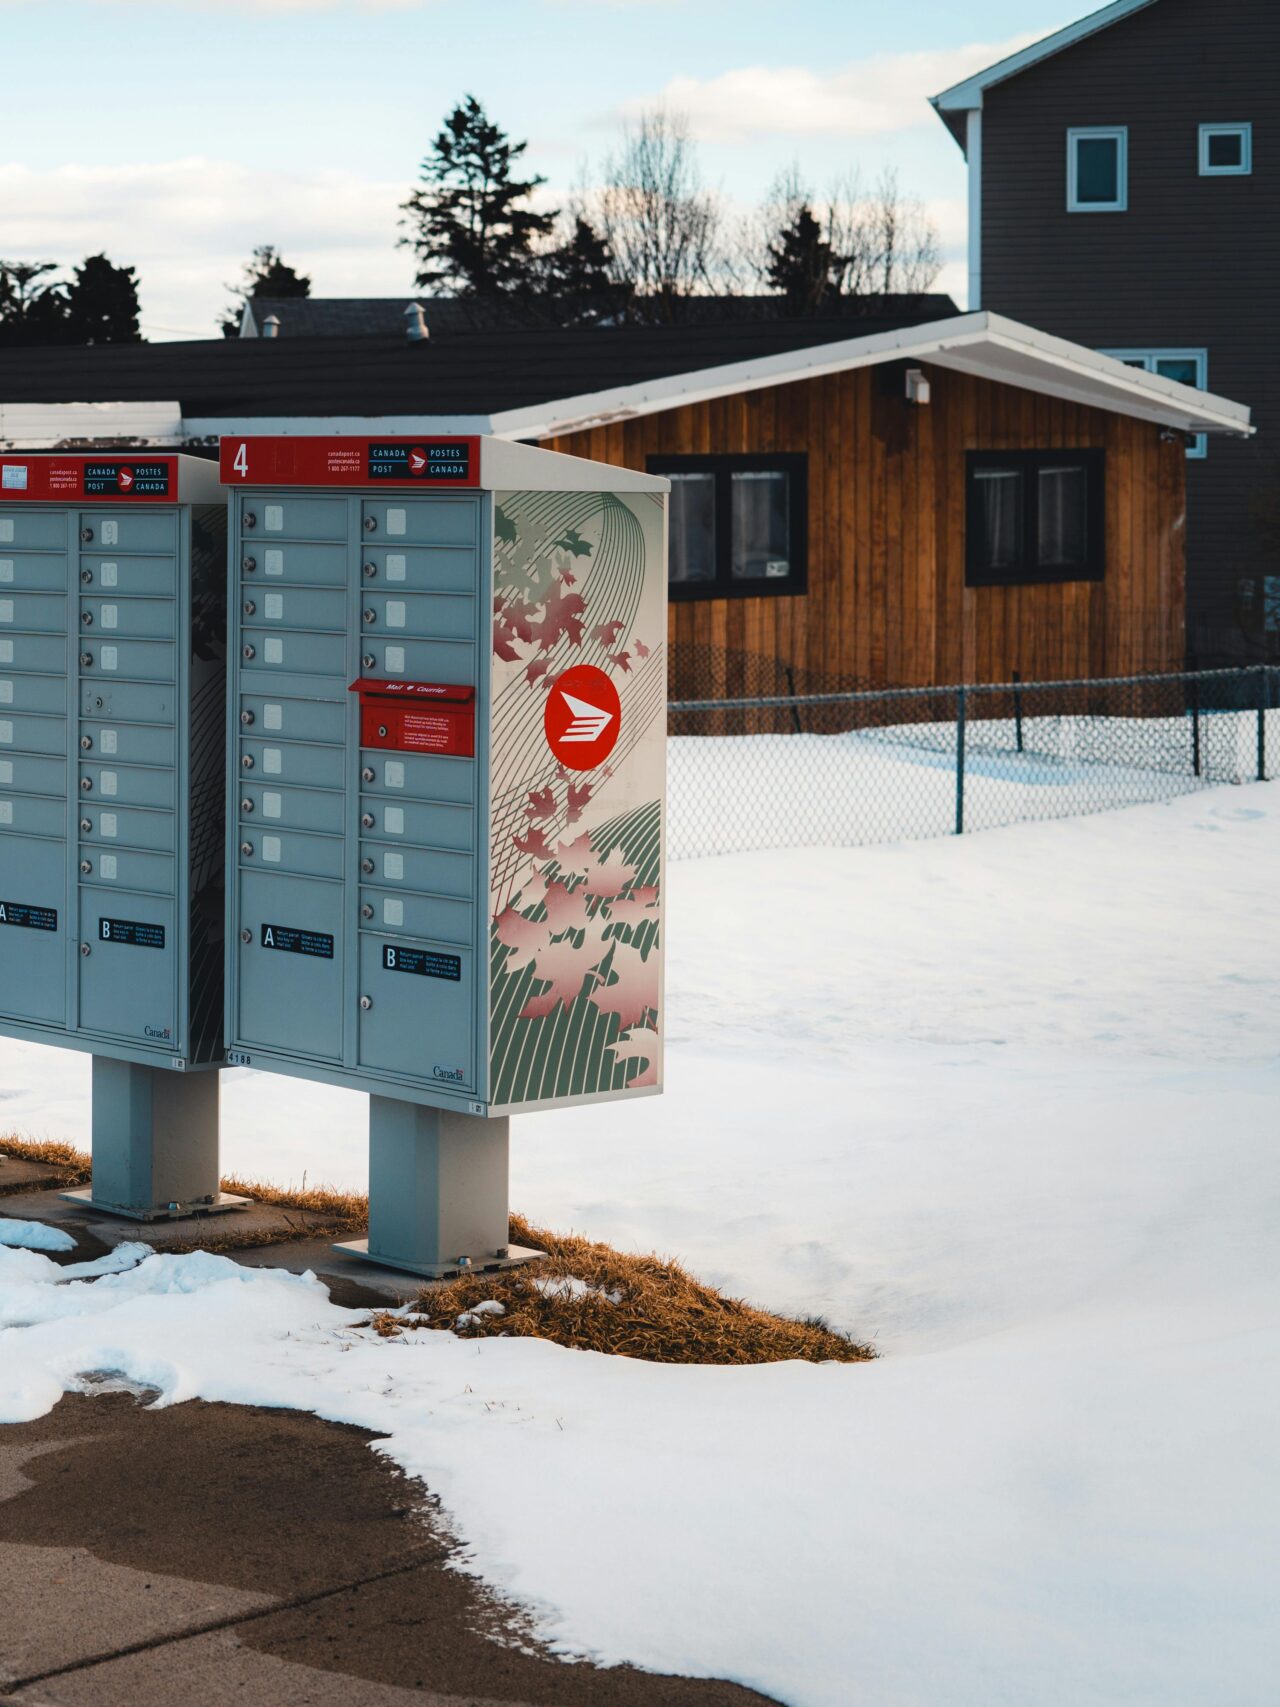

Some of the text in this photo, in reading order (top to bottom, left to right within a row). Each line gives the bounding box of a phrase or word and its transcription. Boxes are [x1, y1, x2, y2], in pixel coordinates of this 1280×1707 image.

[233, 443, 248, 477] 4
[103, 921, 110, 938] B
[264, 928, 274, 946] A
[387, 948, 395, 967] B
[144, 1025, 170, 1039] Canada
[228, 1053, 250, 1064] 4188
[433, 1066, 463, 1080] Canada
